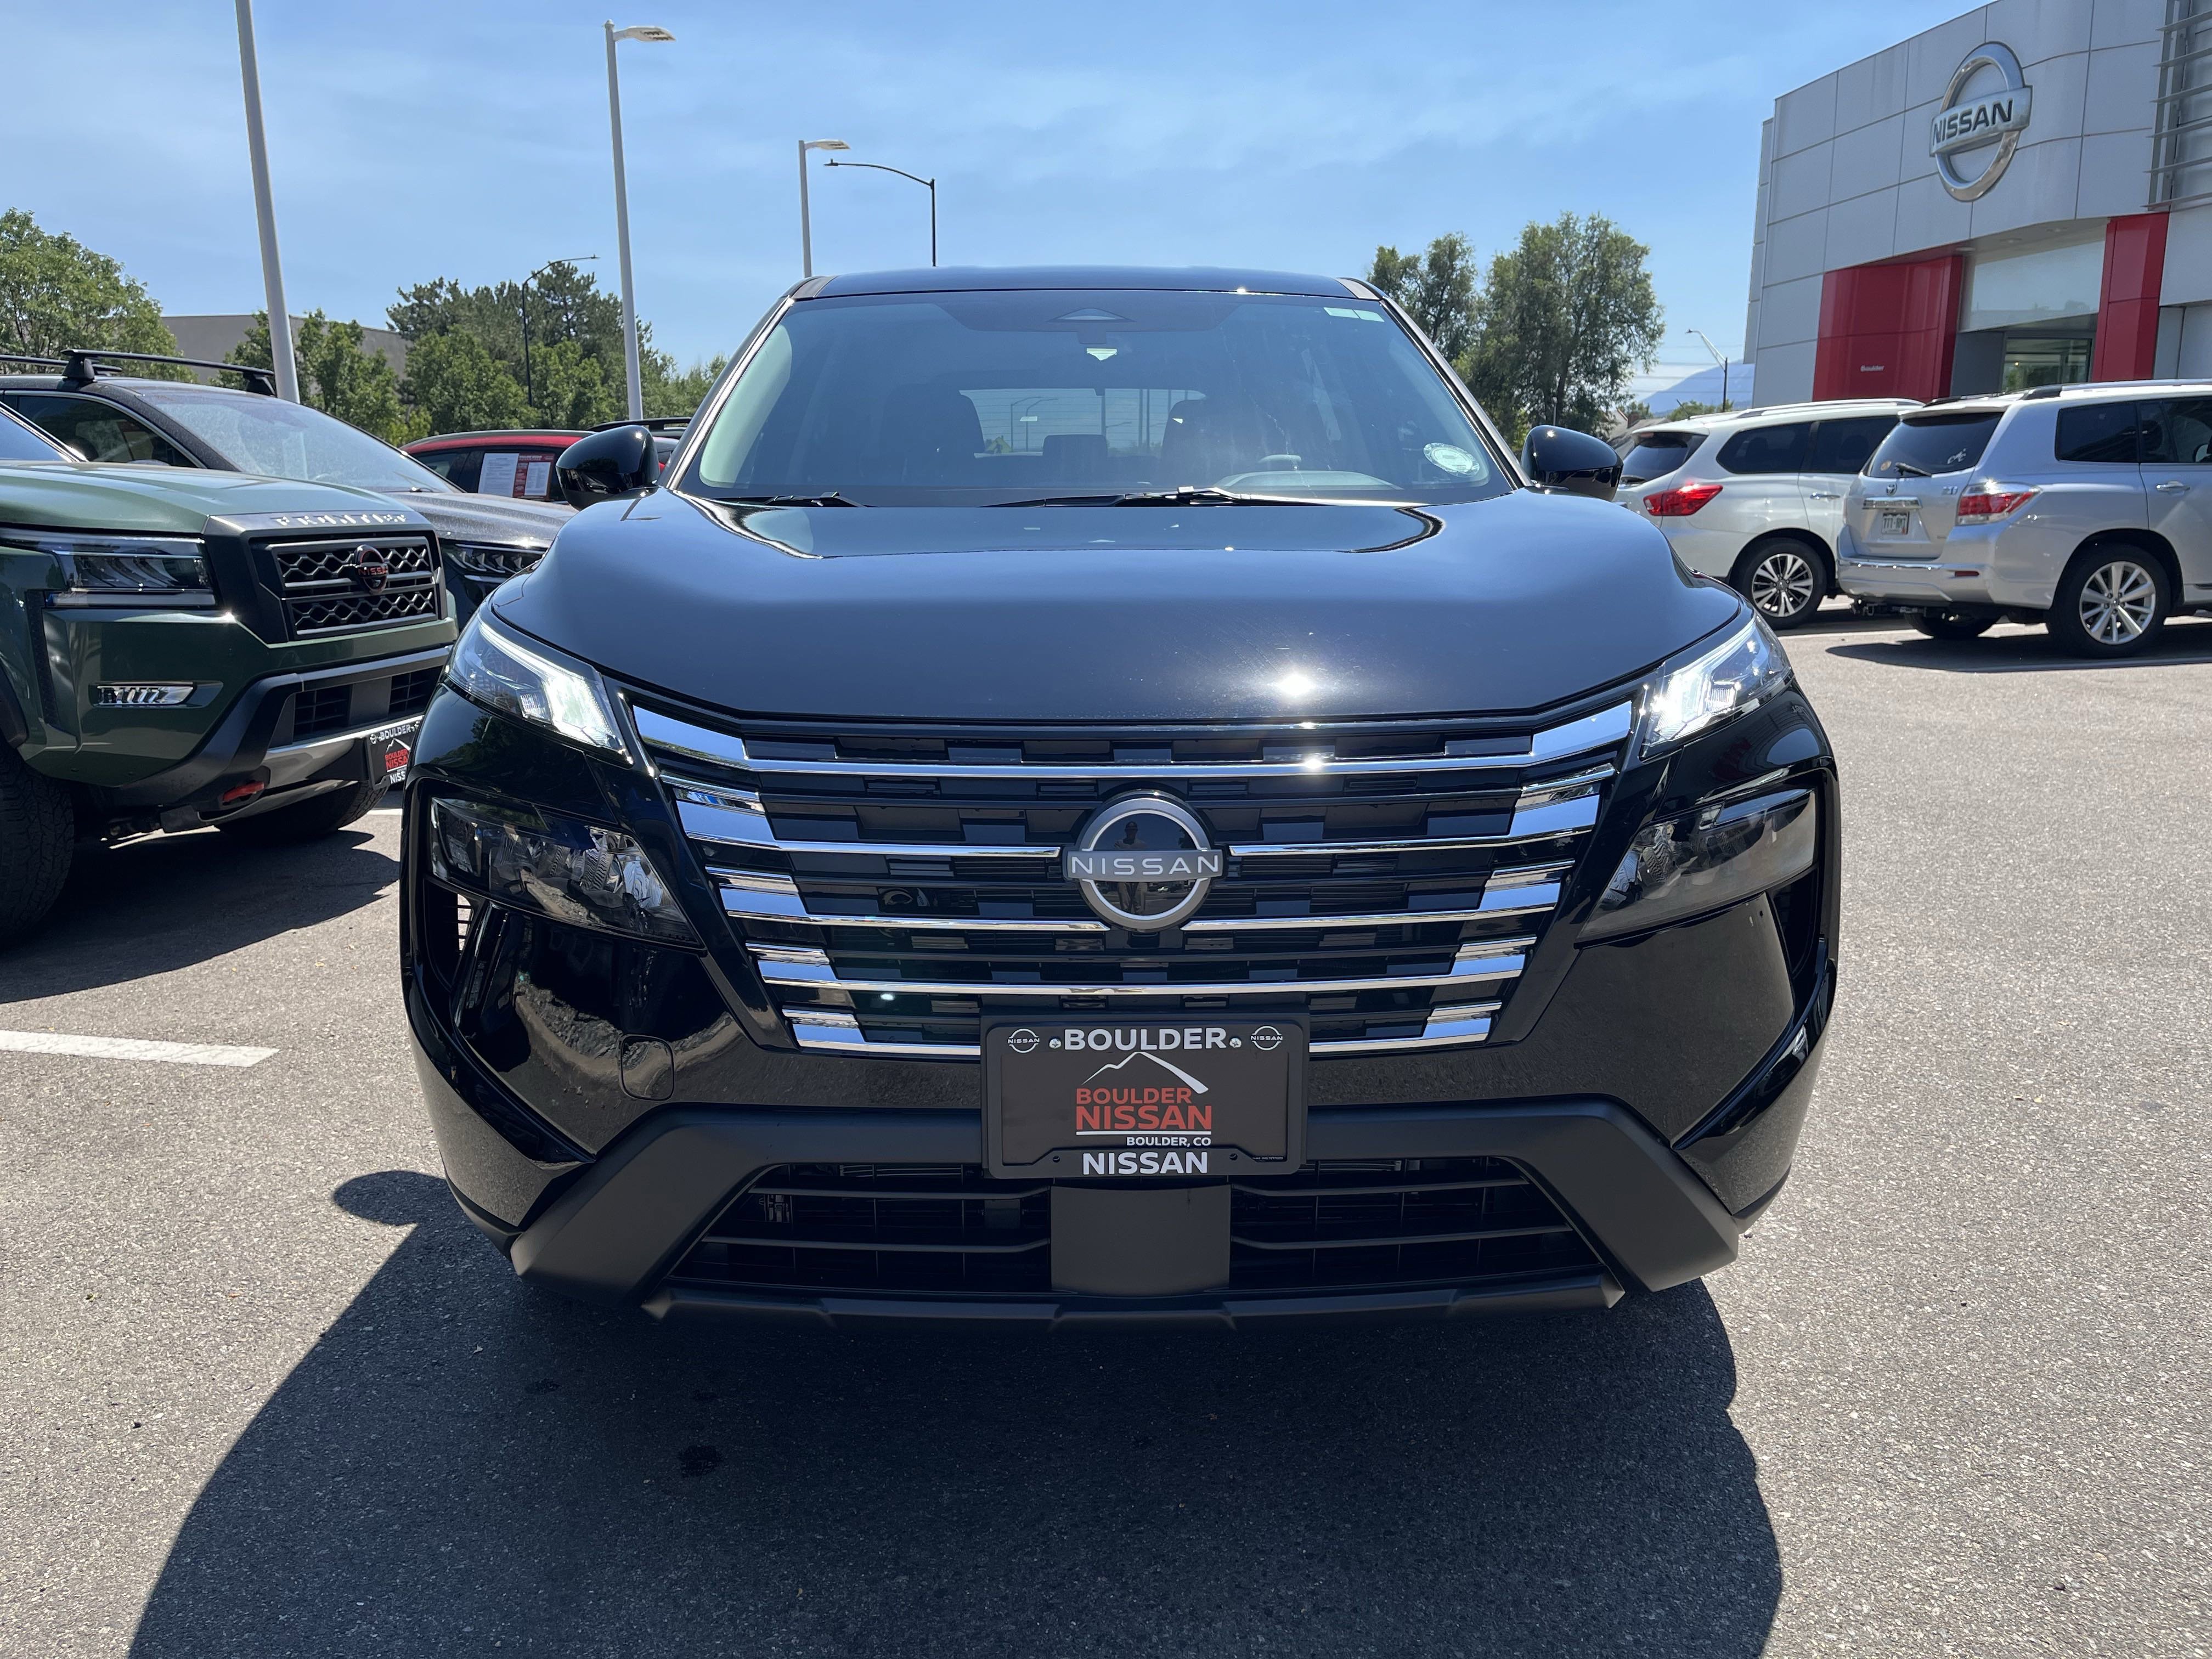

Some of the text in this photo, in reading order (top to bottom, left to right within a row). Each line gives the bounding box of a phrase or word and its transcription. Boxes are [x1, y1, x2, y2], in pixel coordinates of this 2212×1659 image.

[1933, 98, 2013, 145] NISSAN
[358, 566, 387, 575] NISSA
[379, 724, 411, 742] BOULDER
[386, 756, 408, 770] NISSA
[390, 771, 405, 784] NISS
[1071, 855, 1218, 875] NISSAN
[1064, 1027, 1227, 1051] BOULDER
[1076, 1088, 1192, 1104] BOULDER
[1076, 1105, 1212, 1130] NISSAN
[1126, 1137, 1211, 1147] BOULDER, CO
[1082, 1152, 1207, 1175] NISSAN
